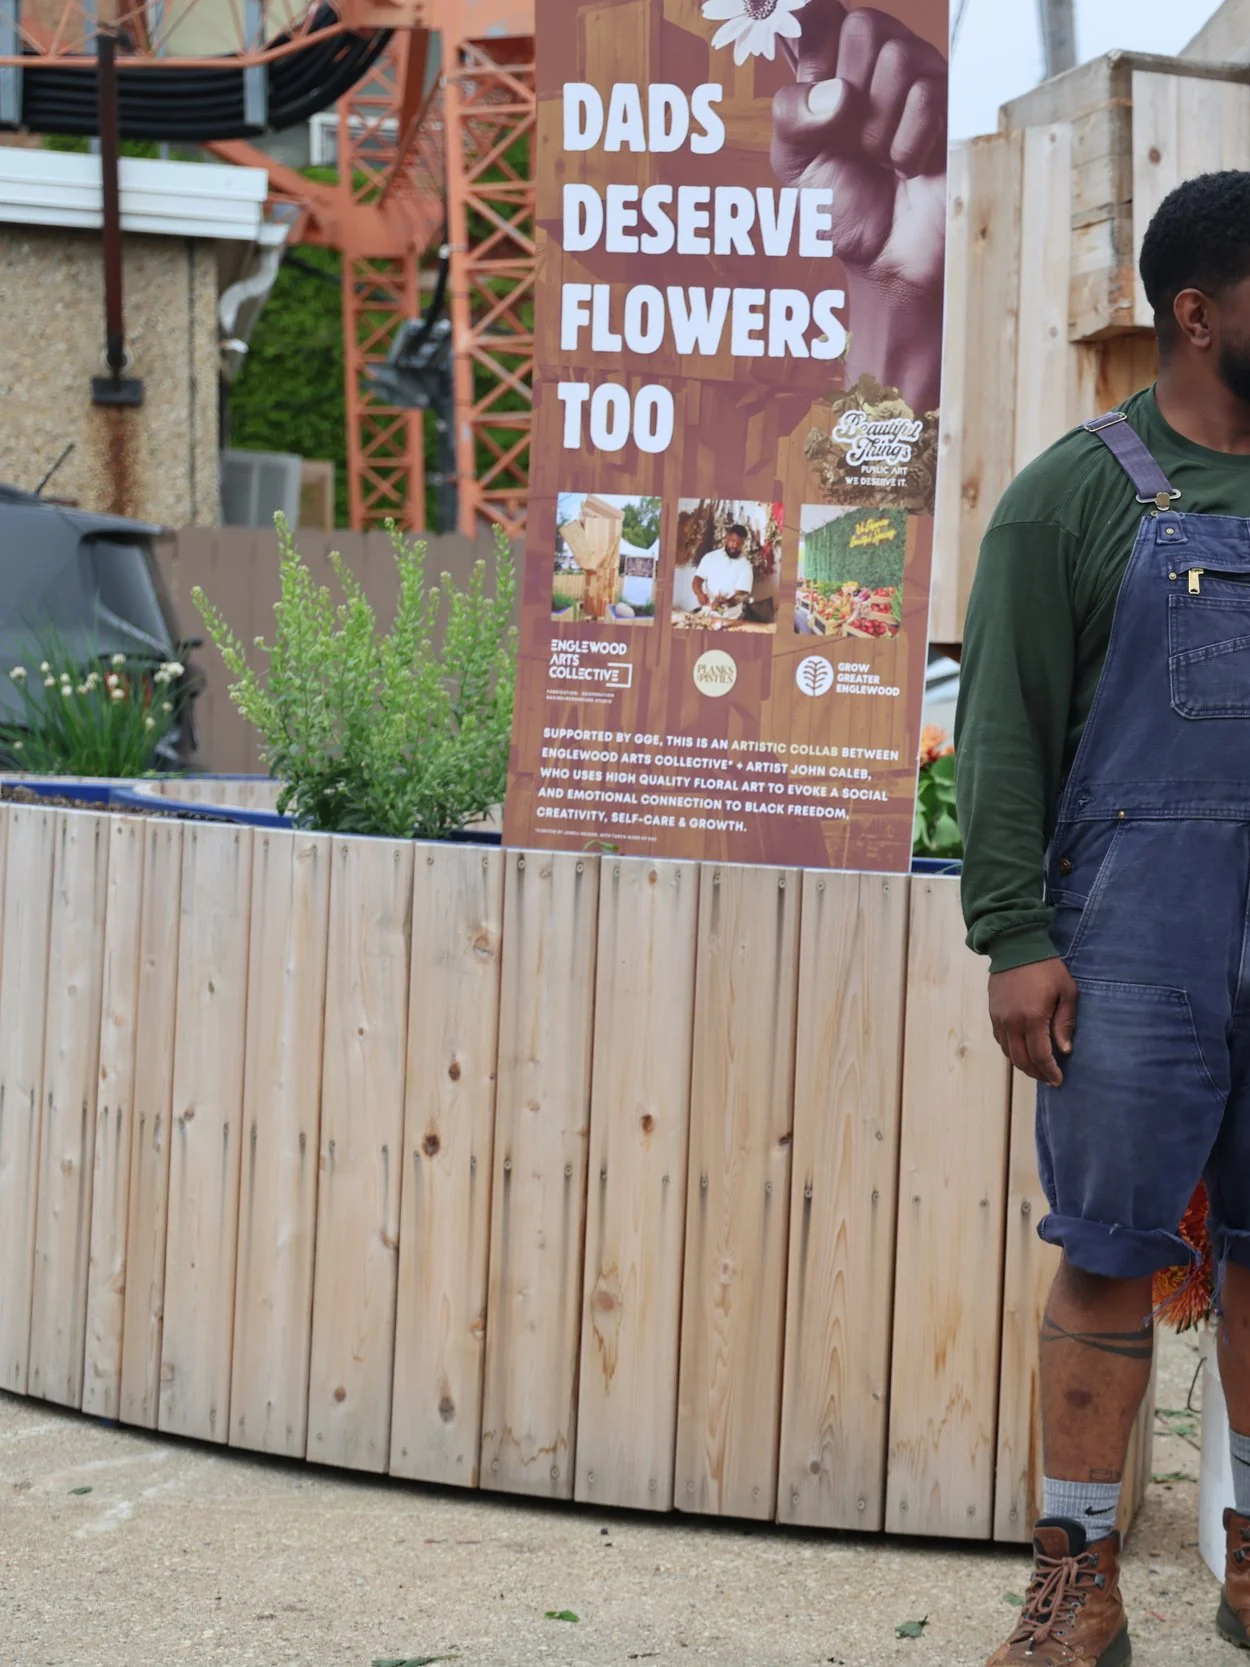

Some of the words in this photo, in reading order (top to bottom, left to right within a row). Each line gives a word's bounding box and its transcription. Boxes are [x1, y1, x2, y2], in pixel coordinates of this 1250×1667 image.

[563, 81, 725, 155] DADS
[562, 183, 834, 258] DESERVE
[560, 282, 847, 360] FLOWERS
[557, 381, 675, 454] TOO
[834, 411, 921, 442] Beautiful
[847, 436, 910, 464] Things
[844, 476, 859, 486] WE
[860, 477, 896, 487] DESERVE
[861, 465, 889, 474] PUBLIC
[891, 466, 908, 476] ART
[549, 652, 580, 666] ARTS
[550, 639, 627, 655] ENGLEWOOD
[548, 666, 620, 682] COLLECTIVE
[837, 673, 880, 684] GREATER
[838, 662, 870, 673] GROW
[836, 684, 900, 696] ENGLEWOOD
[543, 728, 613, 742] SUPPORTED
[616, 732, 631, 743] BY
[634, 733, 663, 747] GGE,
[667, 735, 693, 747] THIS
[697, 738, 708, 748] IS
[711, 739, 728, 750] AN
[731, 740, 787, 753] ARTISTIC
[790, 744, 838, 757] COLLAB
[841, 747, 899, 761] BETWEEN
[541, 747, 618, 763] ENGLEWOOD
[621, 752, 652, 765] ARTS
[746, 761, 788, 774] ARTIST
[790, 764, 826, 777] JOHN
[829, 766, 872, 782] CALEB,
[540, 766, 570, 779] WHO
[573, 769, 602, 781] USES
[606, 772, 636, 784] HIGH
[639, 774, 692, 788] QUALITY
[694, 776, 739, 791] FLORAL
[741, 782, 766, 794] ART
[768, 782, 785, 794] TO
[788, 784, 827, 798] EVOKE
[830, 786, 838, 798] A
[842, 788, 888, 802] SOCIAL
[538, 786, 564, 799] AND
[567, 788, 638, 804] EMOTIONAL
[640, 793, 722, 810] CONNECTION
[725, 800, 742, 812] TO
[744, 801, 785, 815] BLACK
[787, 804, 850, 820] FREEDOM,
[536, 806, 608, 824] CREATIVITY,
[611, 811, 675, 827] SELF-CARE
[678, 816, 686, 828] &
[689, 817, 748, 832] GROWTH.
